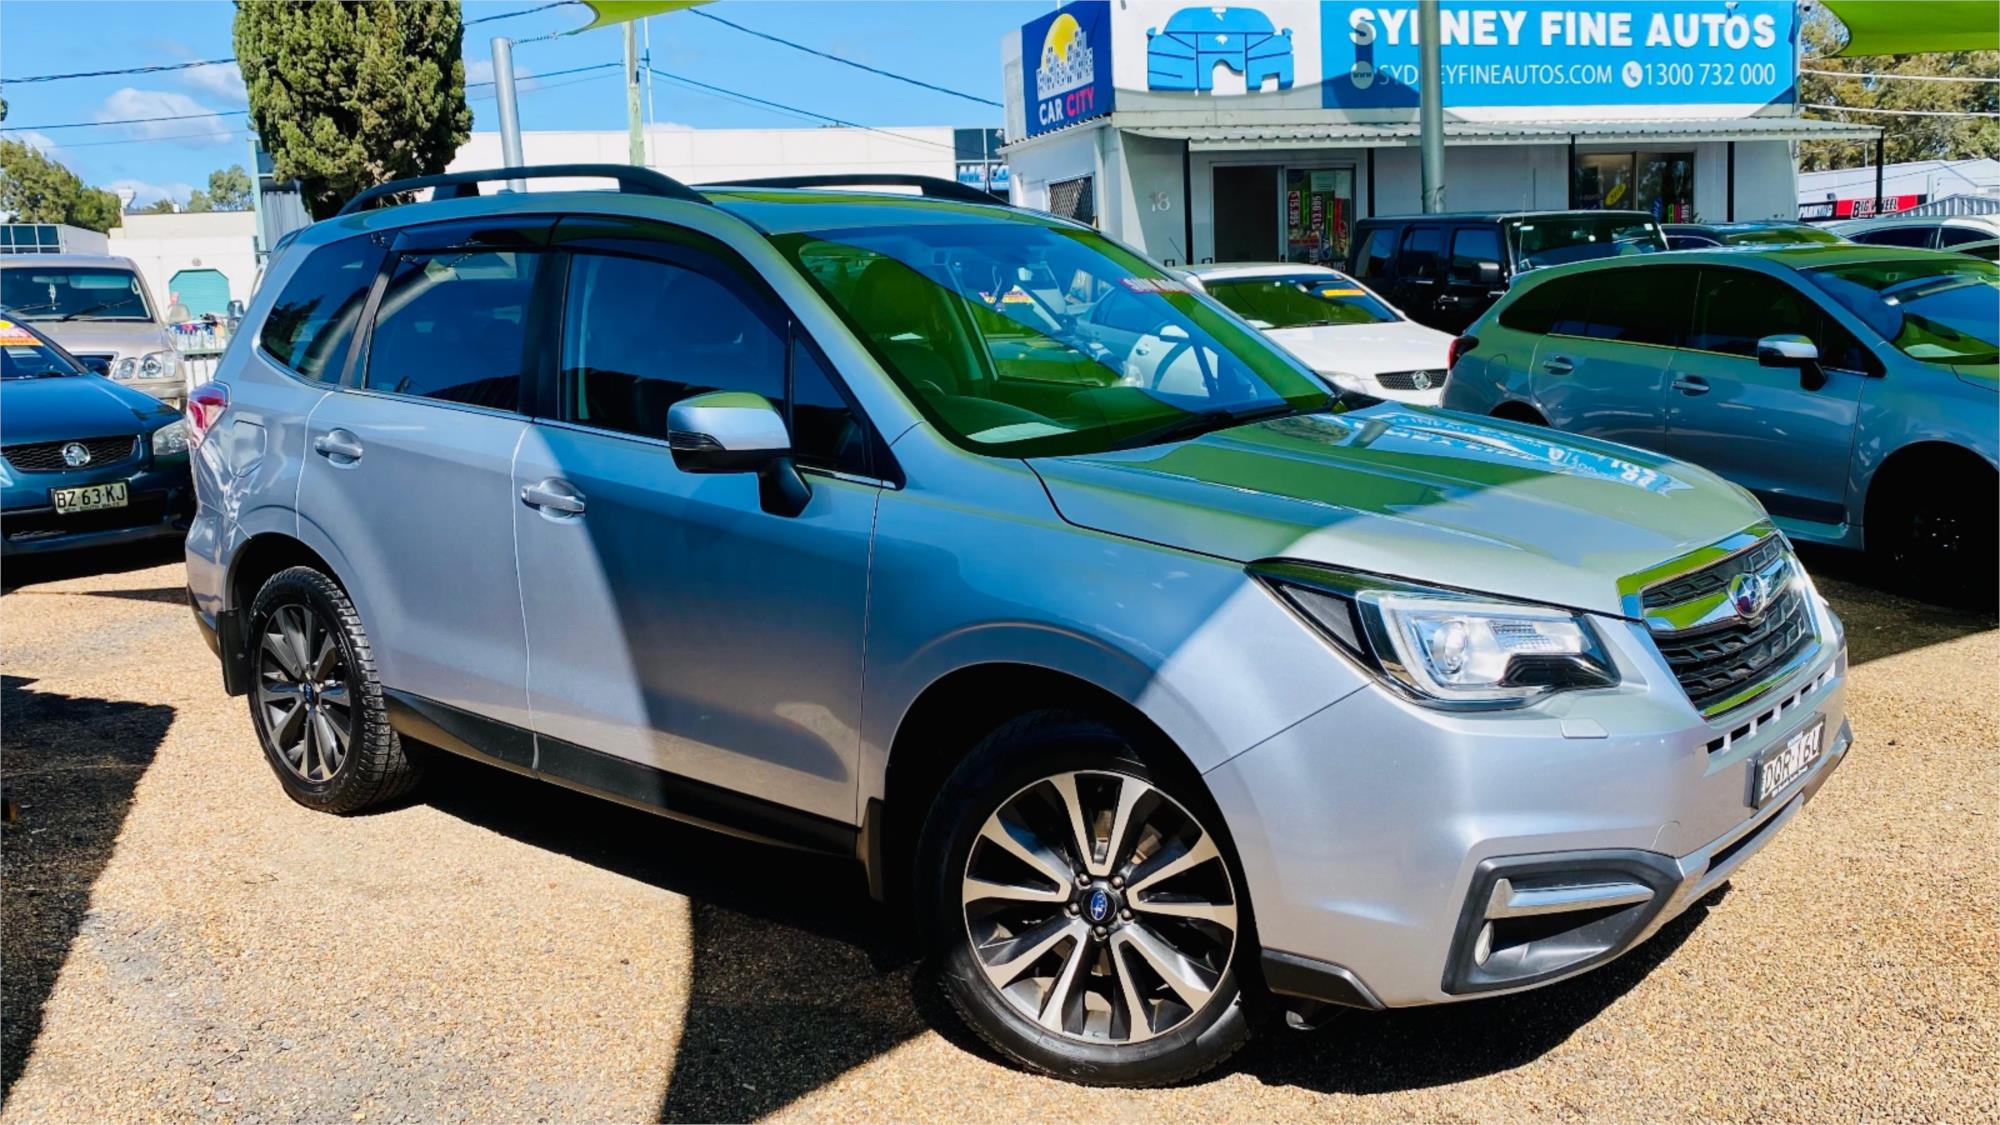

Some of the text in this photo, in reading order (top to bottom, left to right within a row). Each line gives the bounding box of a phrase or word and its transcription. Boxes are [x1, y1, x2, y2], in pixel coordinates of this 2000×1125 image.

[1540, 10, 1633, 47] FINE
[1645, 12, 1776, 50] AUTOS
[1379, 64, 1613, 85] SYDYFINEAUTOS.COM
[1645, 63, 1776, 86] 1300 732 000
[1039, 86, 1095, 126] CAR CITY
